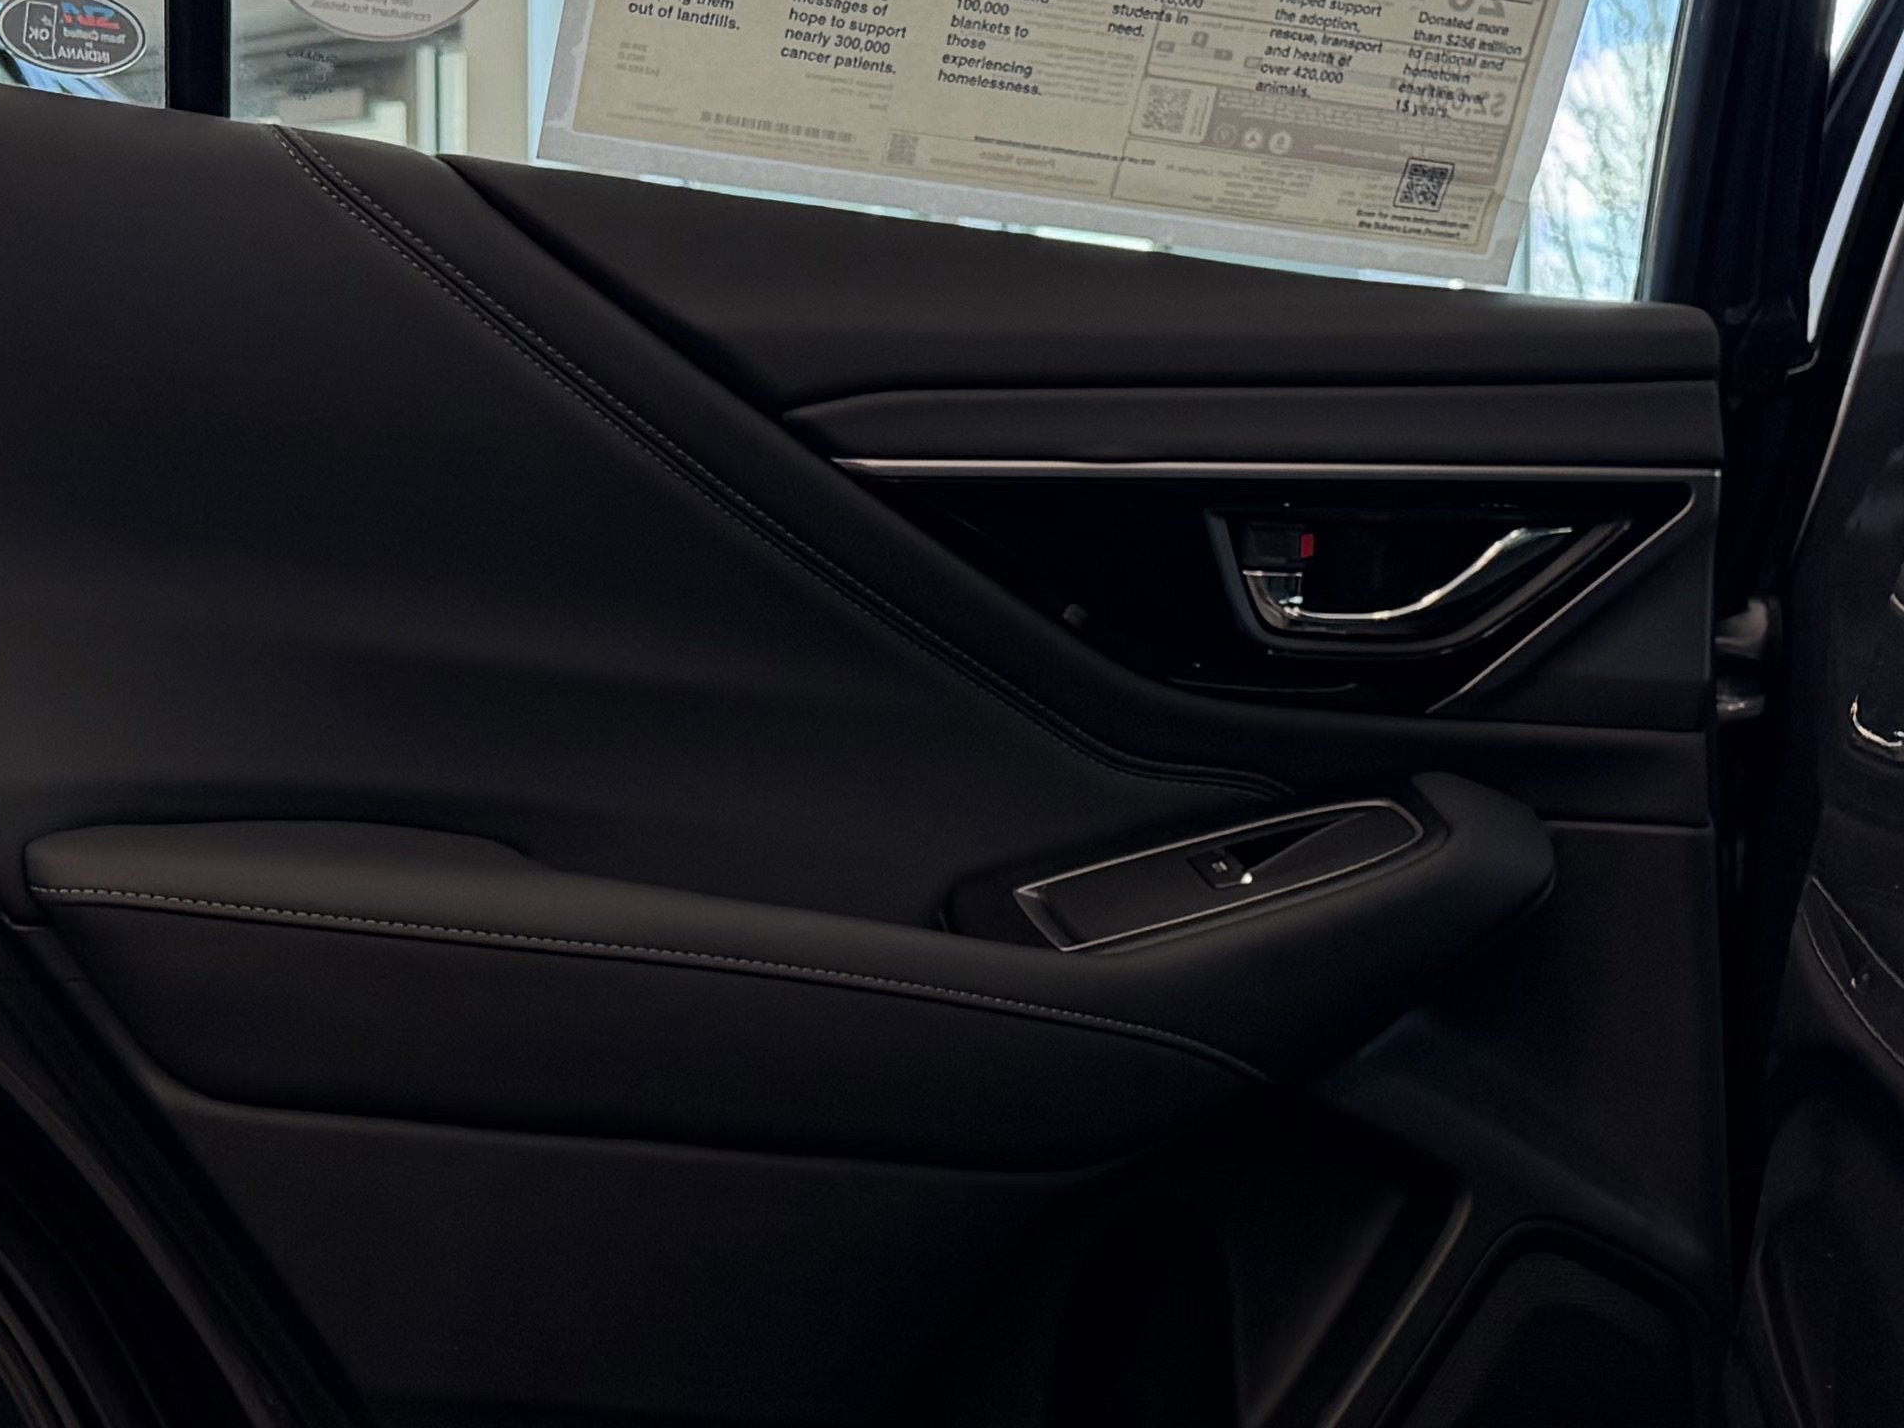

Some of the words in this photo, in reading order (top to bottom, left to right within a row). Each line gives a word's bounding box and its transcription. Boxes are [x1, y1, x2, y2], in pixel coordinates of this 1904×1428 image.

[628, 2, 653, 15] out
[657, 5, 673, 18] of
[676, 7, 739, 29] landfills.
[872, 3, 888, 16] of
[1111, 3, 1171, 22] students
[1175, 9, 1188, 24] in
[1329, 0, 1382, 16] support
[788, 7, 826, 26] hope
[830, 15, 845, 28] to
[848, 20, 906, 38] support
[950, 14, 1010, 35] blankets
[1014, 25, 1028, 38] to
[1107, 22, 1144, 36] need.
[1274, 8, 1296, 22] the
[1295, 13, 1360, 37] adoption,
[1416, 10, 1475, 31] Donated
[1474, 21, 1510, 37] more
[784, 28, 830, 47] nearly
[834, 34, 890, 54] 300,000
[946, 33, 986, 50] those
[1269, 28, 1317, 45] rescue,
[1321, 33, 1383, 53] transport
[1411, 27, 1444, 45] than
[780, 46, 831, 63] cancer
[833, 55, 895, 74] patients.
[942, 53, 1032, 78] experiencing
[1264, 45, 1291, 57] and
[1293, 47, 1334, 65] health
[1337, 55, 1352, 67] of
[1407, 46, 1423, 60] to
[1478, 56, 1505, 72] and
[937, 68, 1041, 95] homelessness.
[1259, 63, 1290, 75] over
[1293, 65, 1343, 83] 420,000
[1401, 62, 1472, 85] hometown
[1255, 81, 1310, 98] animals.
